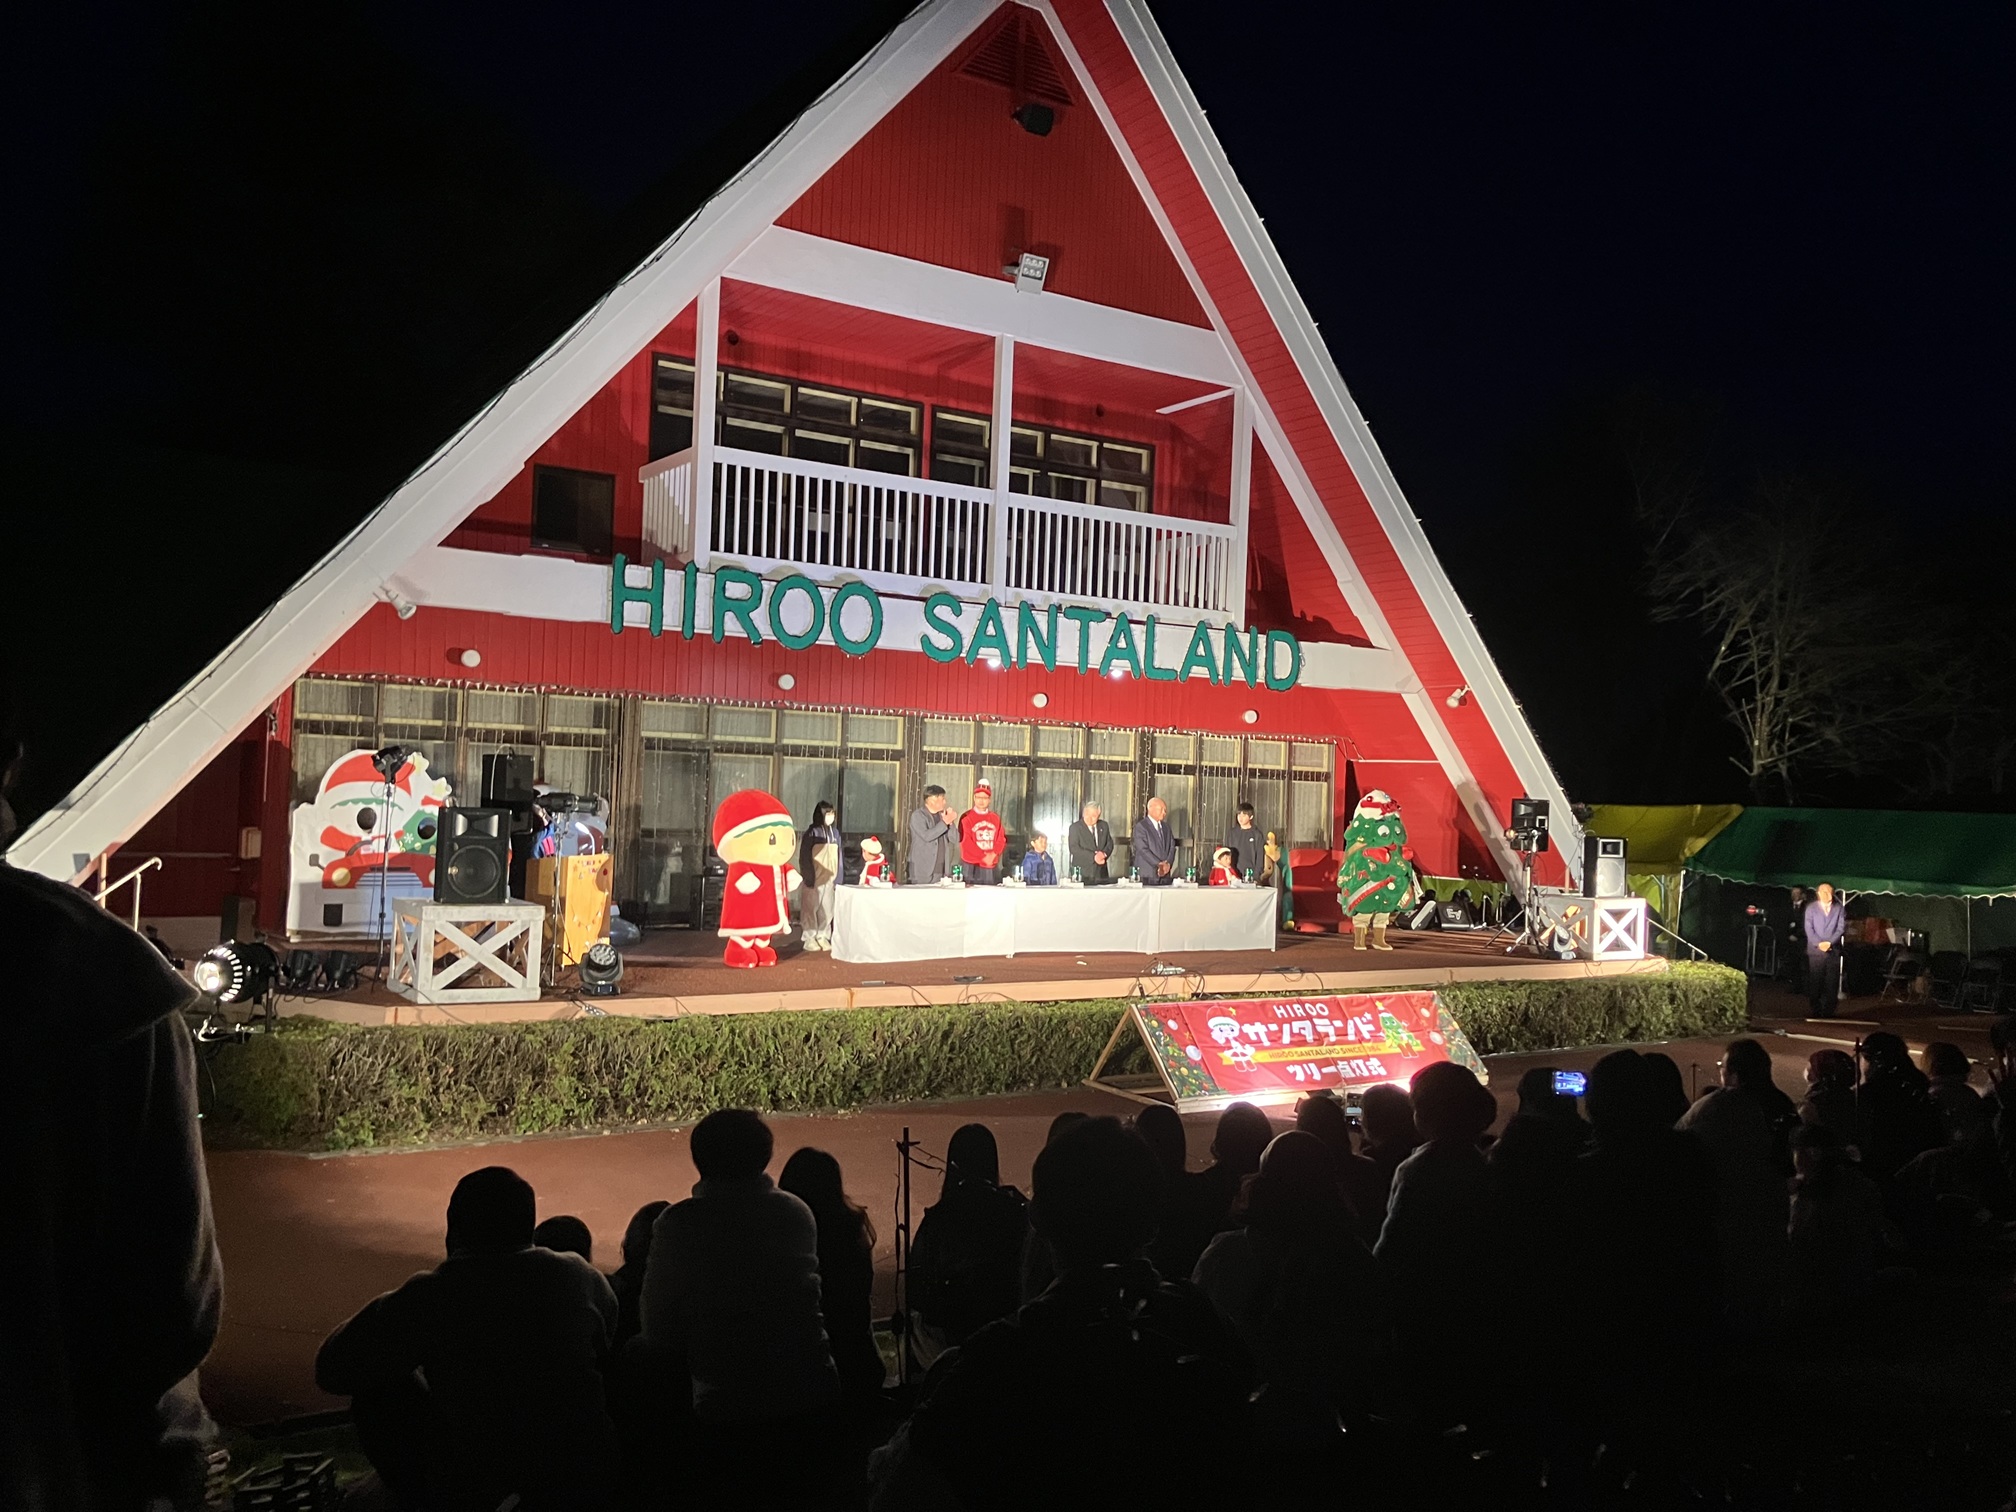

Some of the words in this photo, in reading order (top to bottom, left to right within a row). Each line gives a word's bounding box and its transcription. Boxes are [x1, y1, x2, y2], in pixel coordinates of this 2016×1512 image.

[611, 553, 882, 656] HIROO
[921, 593, 1303, 691] SANTALAND
[1274, 1003, 1329, 1018] HIROO
[1242, 1013, 1375, 1046] サンタランド
[1295, 1047, 1340, 1058] SANTALAND
[1341, 1046, 1362, 1055] SINCE
[1287, 1059, 1387, 1081] ツリー点灯式
